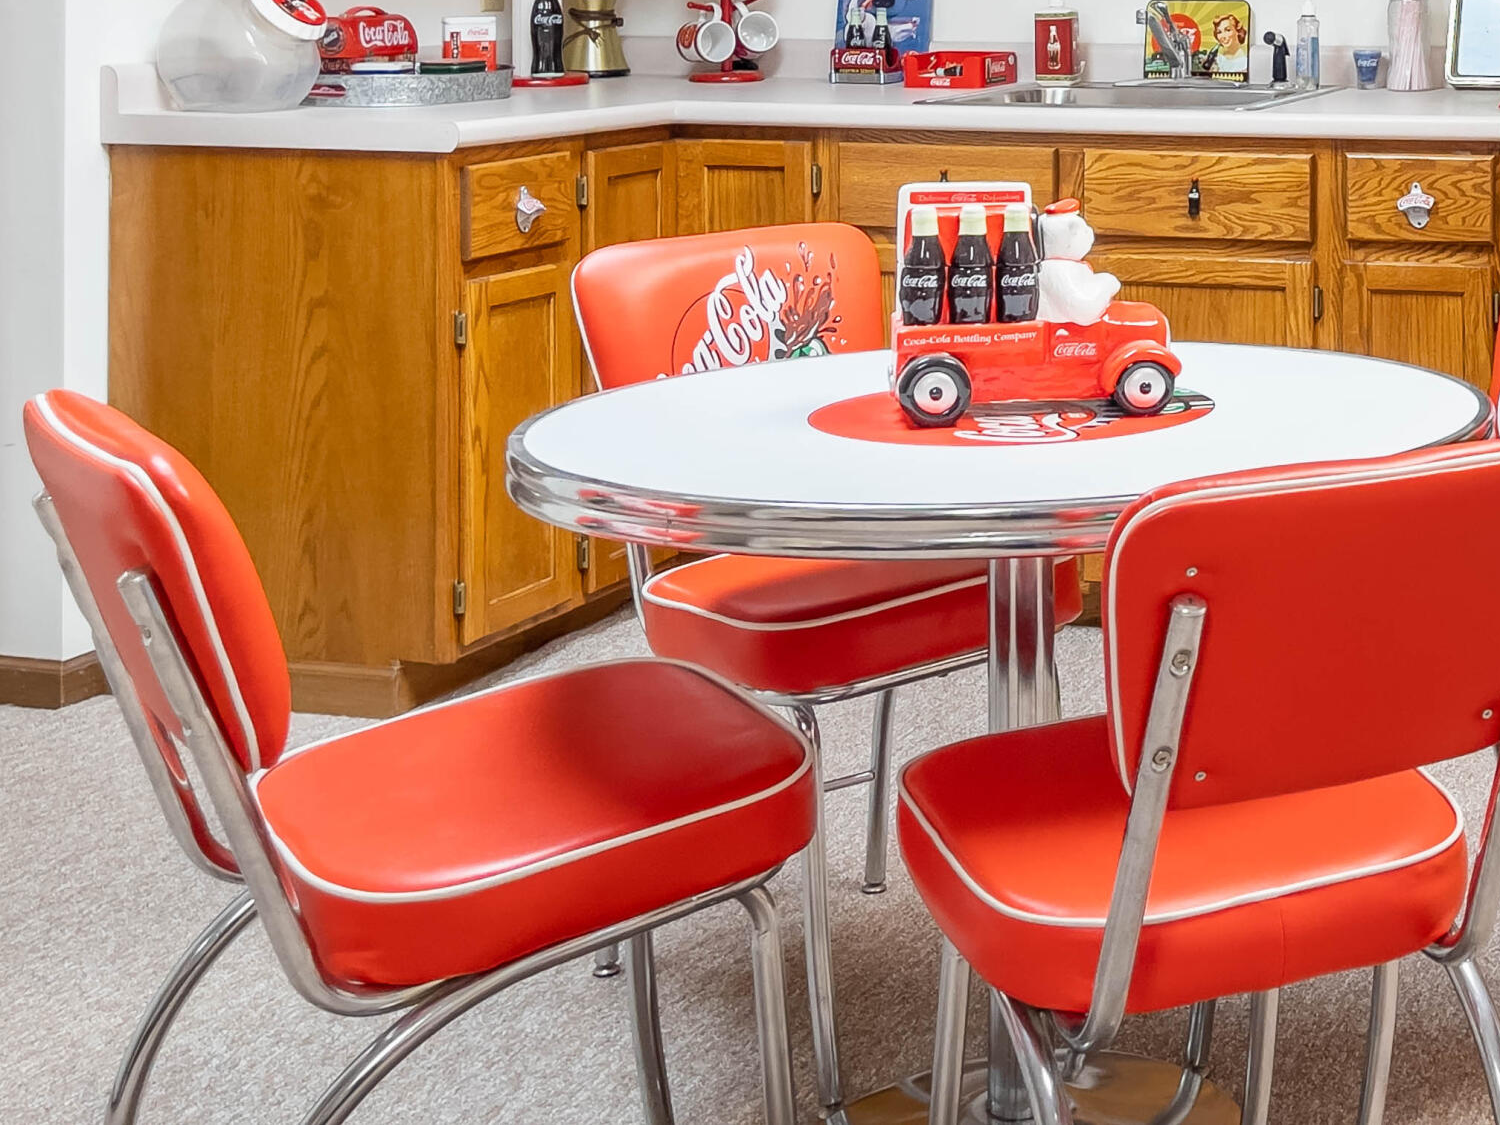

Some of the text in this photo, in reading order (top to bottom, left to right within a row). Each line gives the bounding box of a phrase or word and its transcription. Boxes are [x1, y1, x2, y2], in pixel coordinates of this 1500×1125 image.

[358, 20, 410, 49] Coca-Cola
[903, 274, 939, 288] Coca-Cola
[951, 274, 988, 288] Coca-Cola
[1001, 273, 1036, 287] Coca-Cola
[903, 331, 1037, 347] Coca-Cola Bottling Company
[1053, 342, 1097, 358] Coca-Cola
